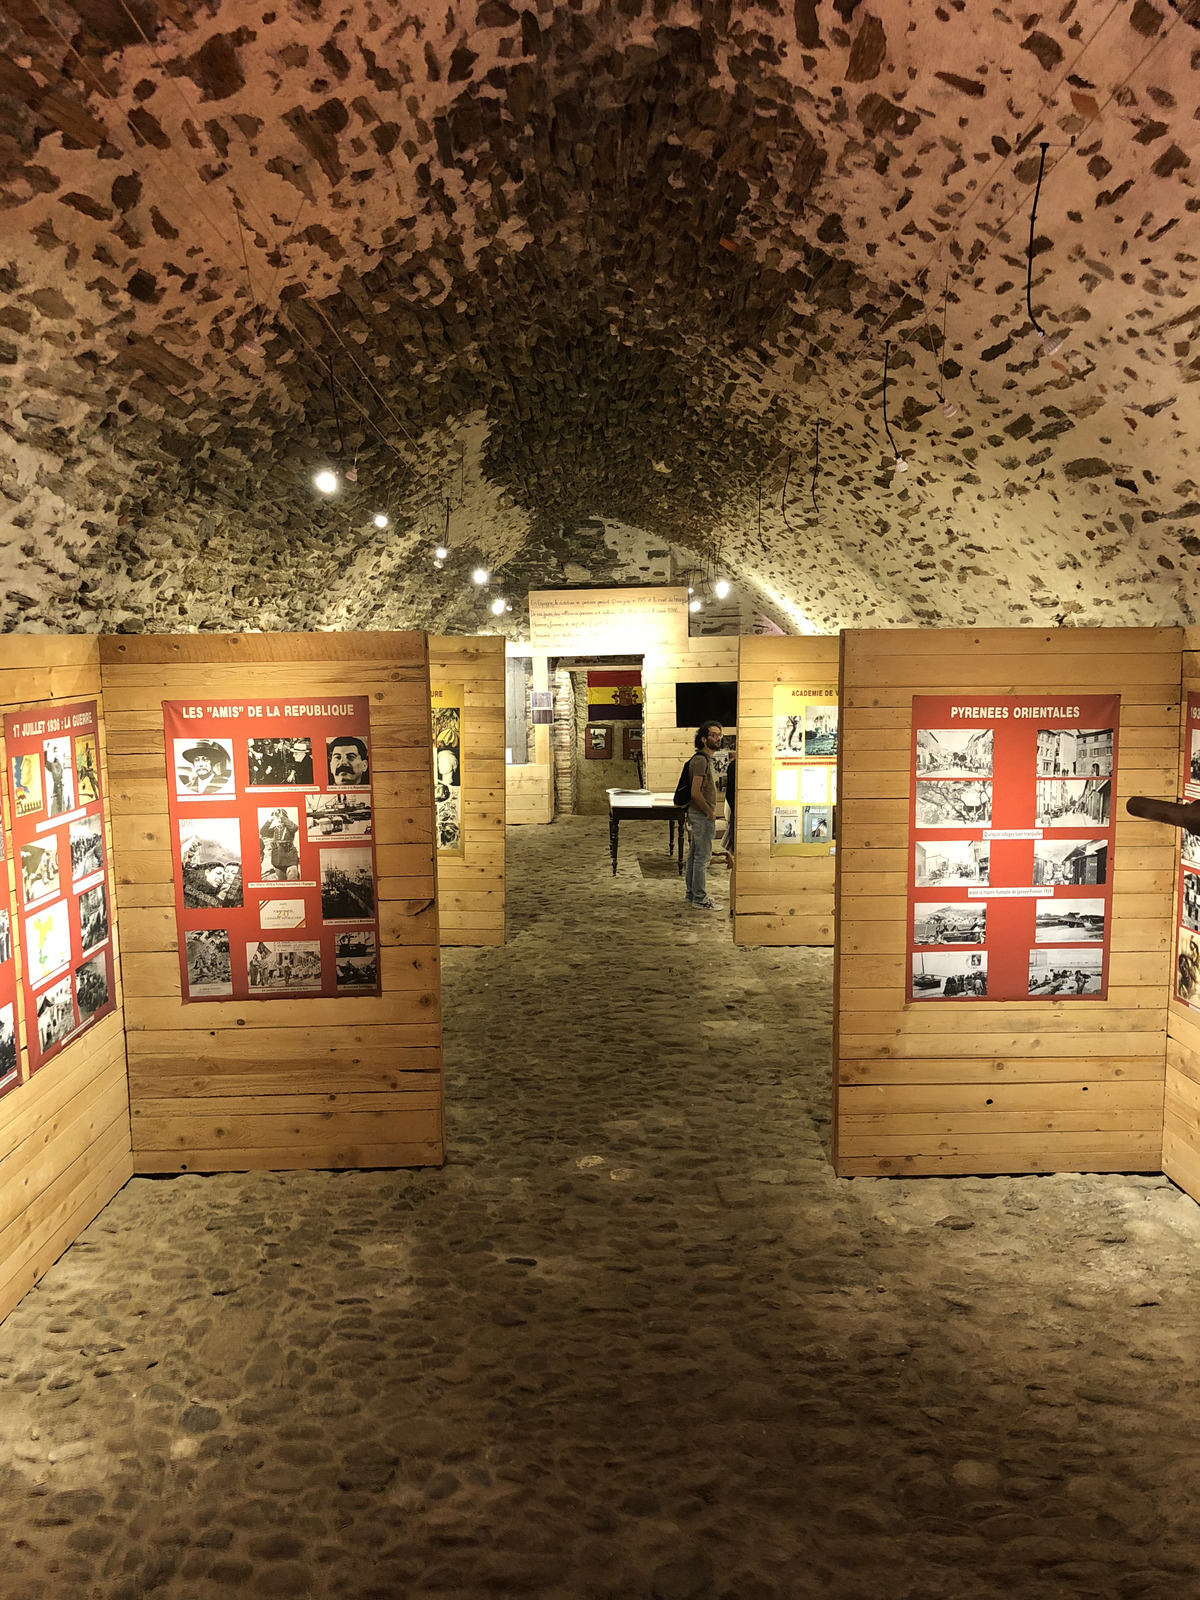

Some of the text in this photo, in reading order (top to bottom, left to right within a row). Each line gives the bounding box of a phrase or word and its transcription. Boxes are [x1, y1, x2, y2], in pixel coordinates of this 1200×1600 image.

[182, 704, 354, 718] LES "AMIS" DE LA REPUBLIQUE
[951, 706, 1080, 719] PYRENEES ORIENTALES
[13, 724, 20, 738] 17
[22, 720, 46, 737] JUILLET
[47, 718, 60, 733] 1936
[64, 716, 71, 729] LA
[72, 712, 93, 727] GUERRE
